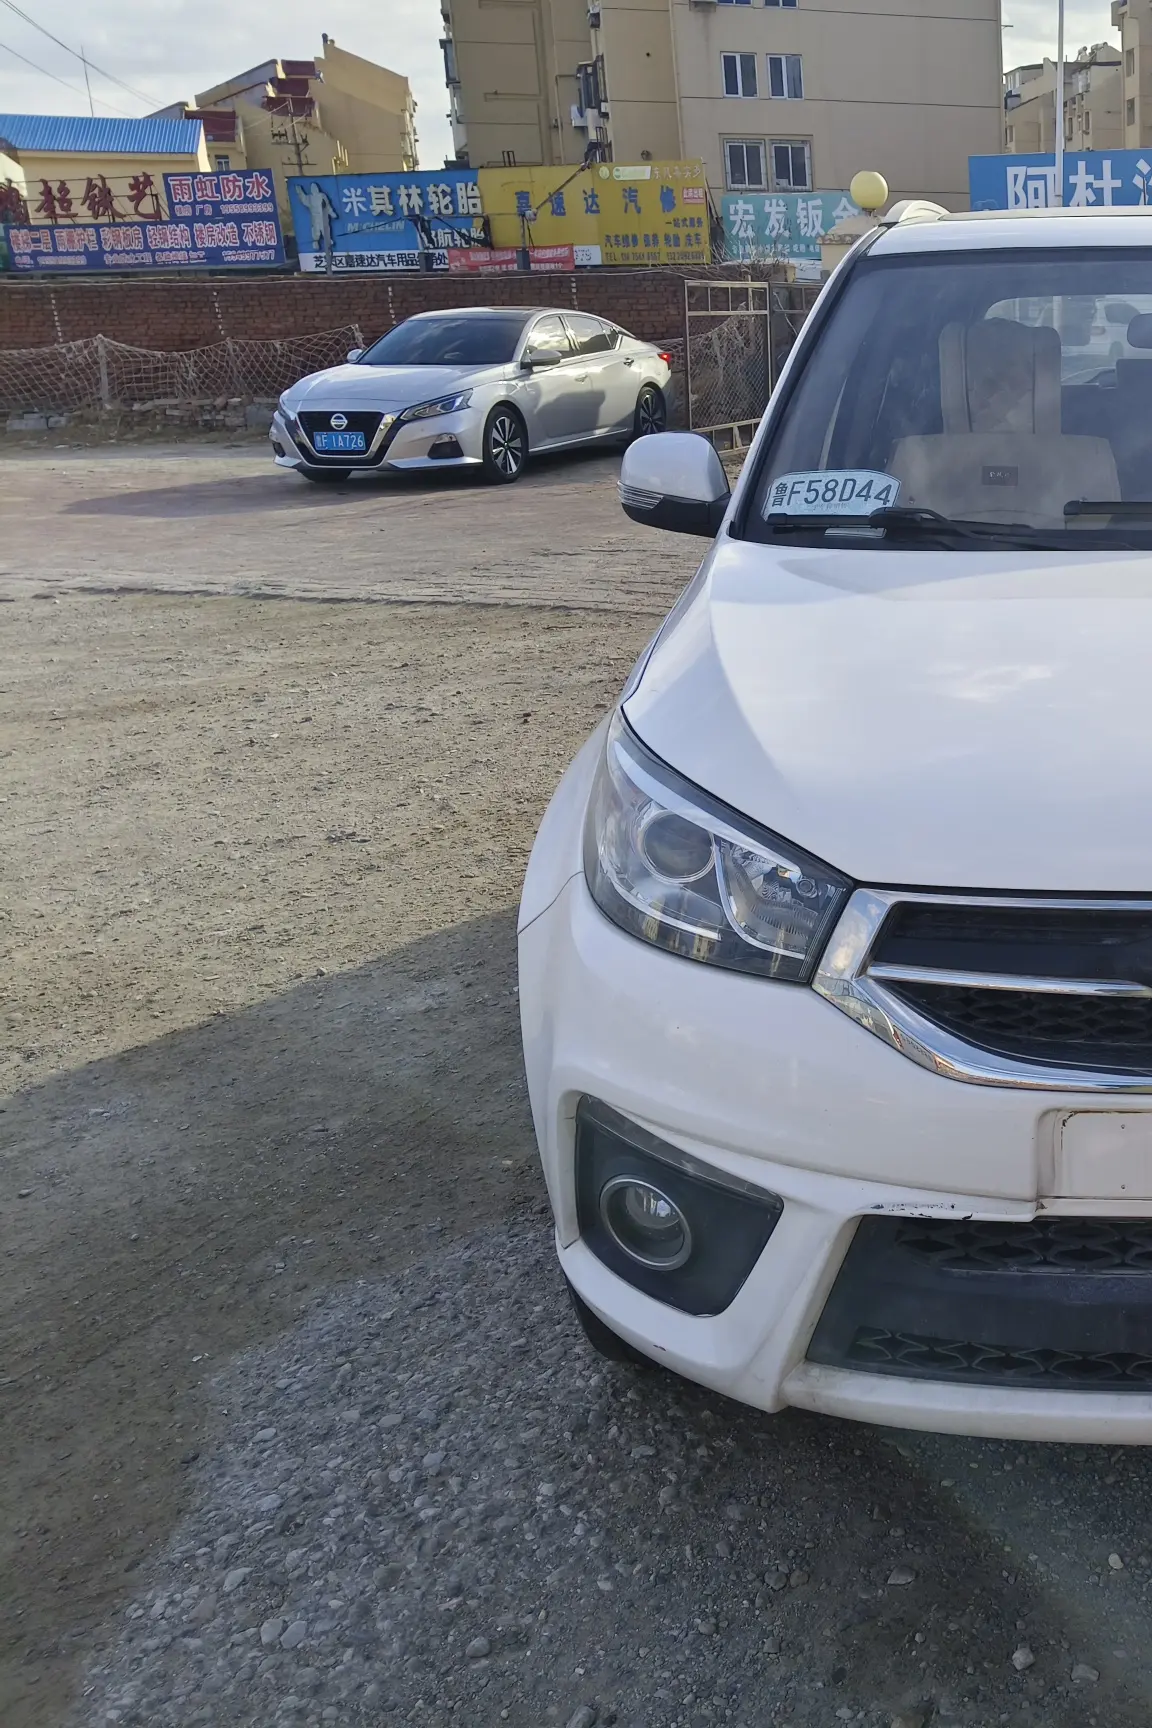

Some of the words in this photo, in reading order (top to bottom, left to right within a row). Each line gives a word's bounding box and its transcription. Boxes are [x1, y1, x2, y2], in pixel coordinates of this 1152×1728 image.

[168, 172, 271, 202] 雨虹防水
[342, 181, 482, 216] 米其林轮胎
[194, 221, 239, 248] 楼房改造
[241, 220, 277, 246] 不锈钢
[314, 251, 449, 269] 芝区嘉速达汽车用品务处
[771, 478, 893, 507] 鲁F58D44
